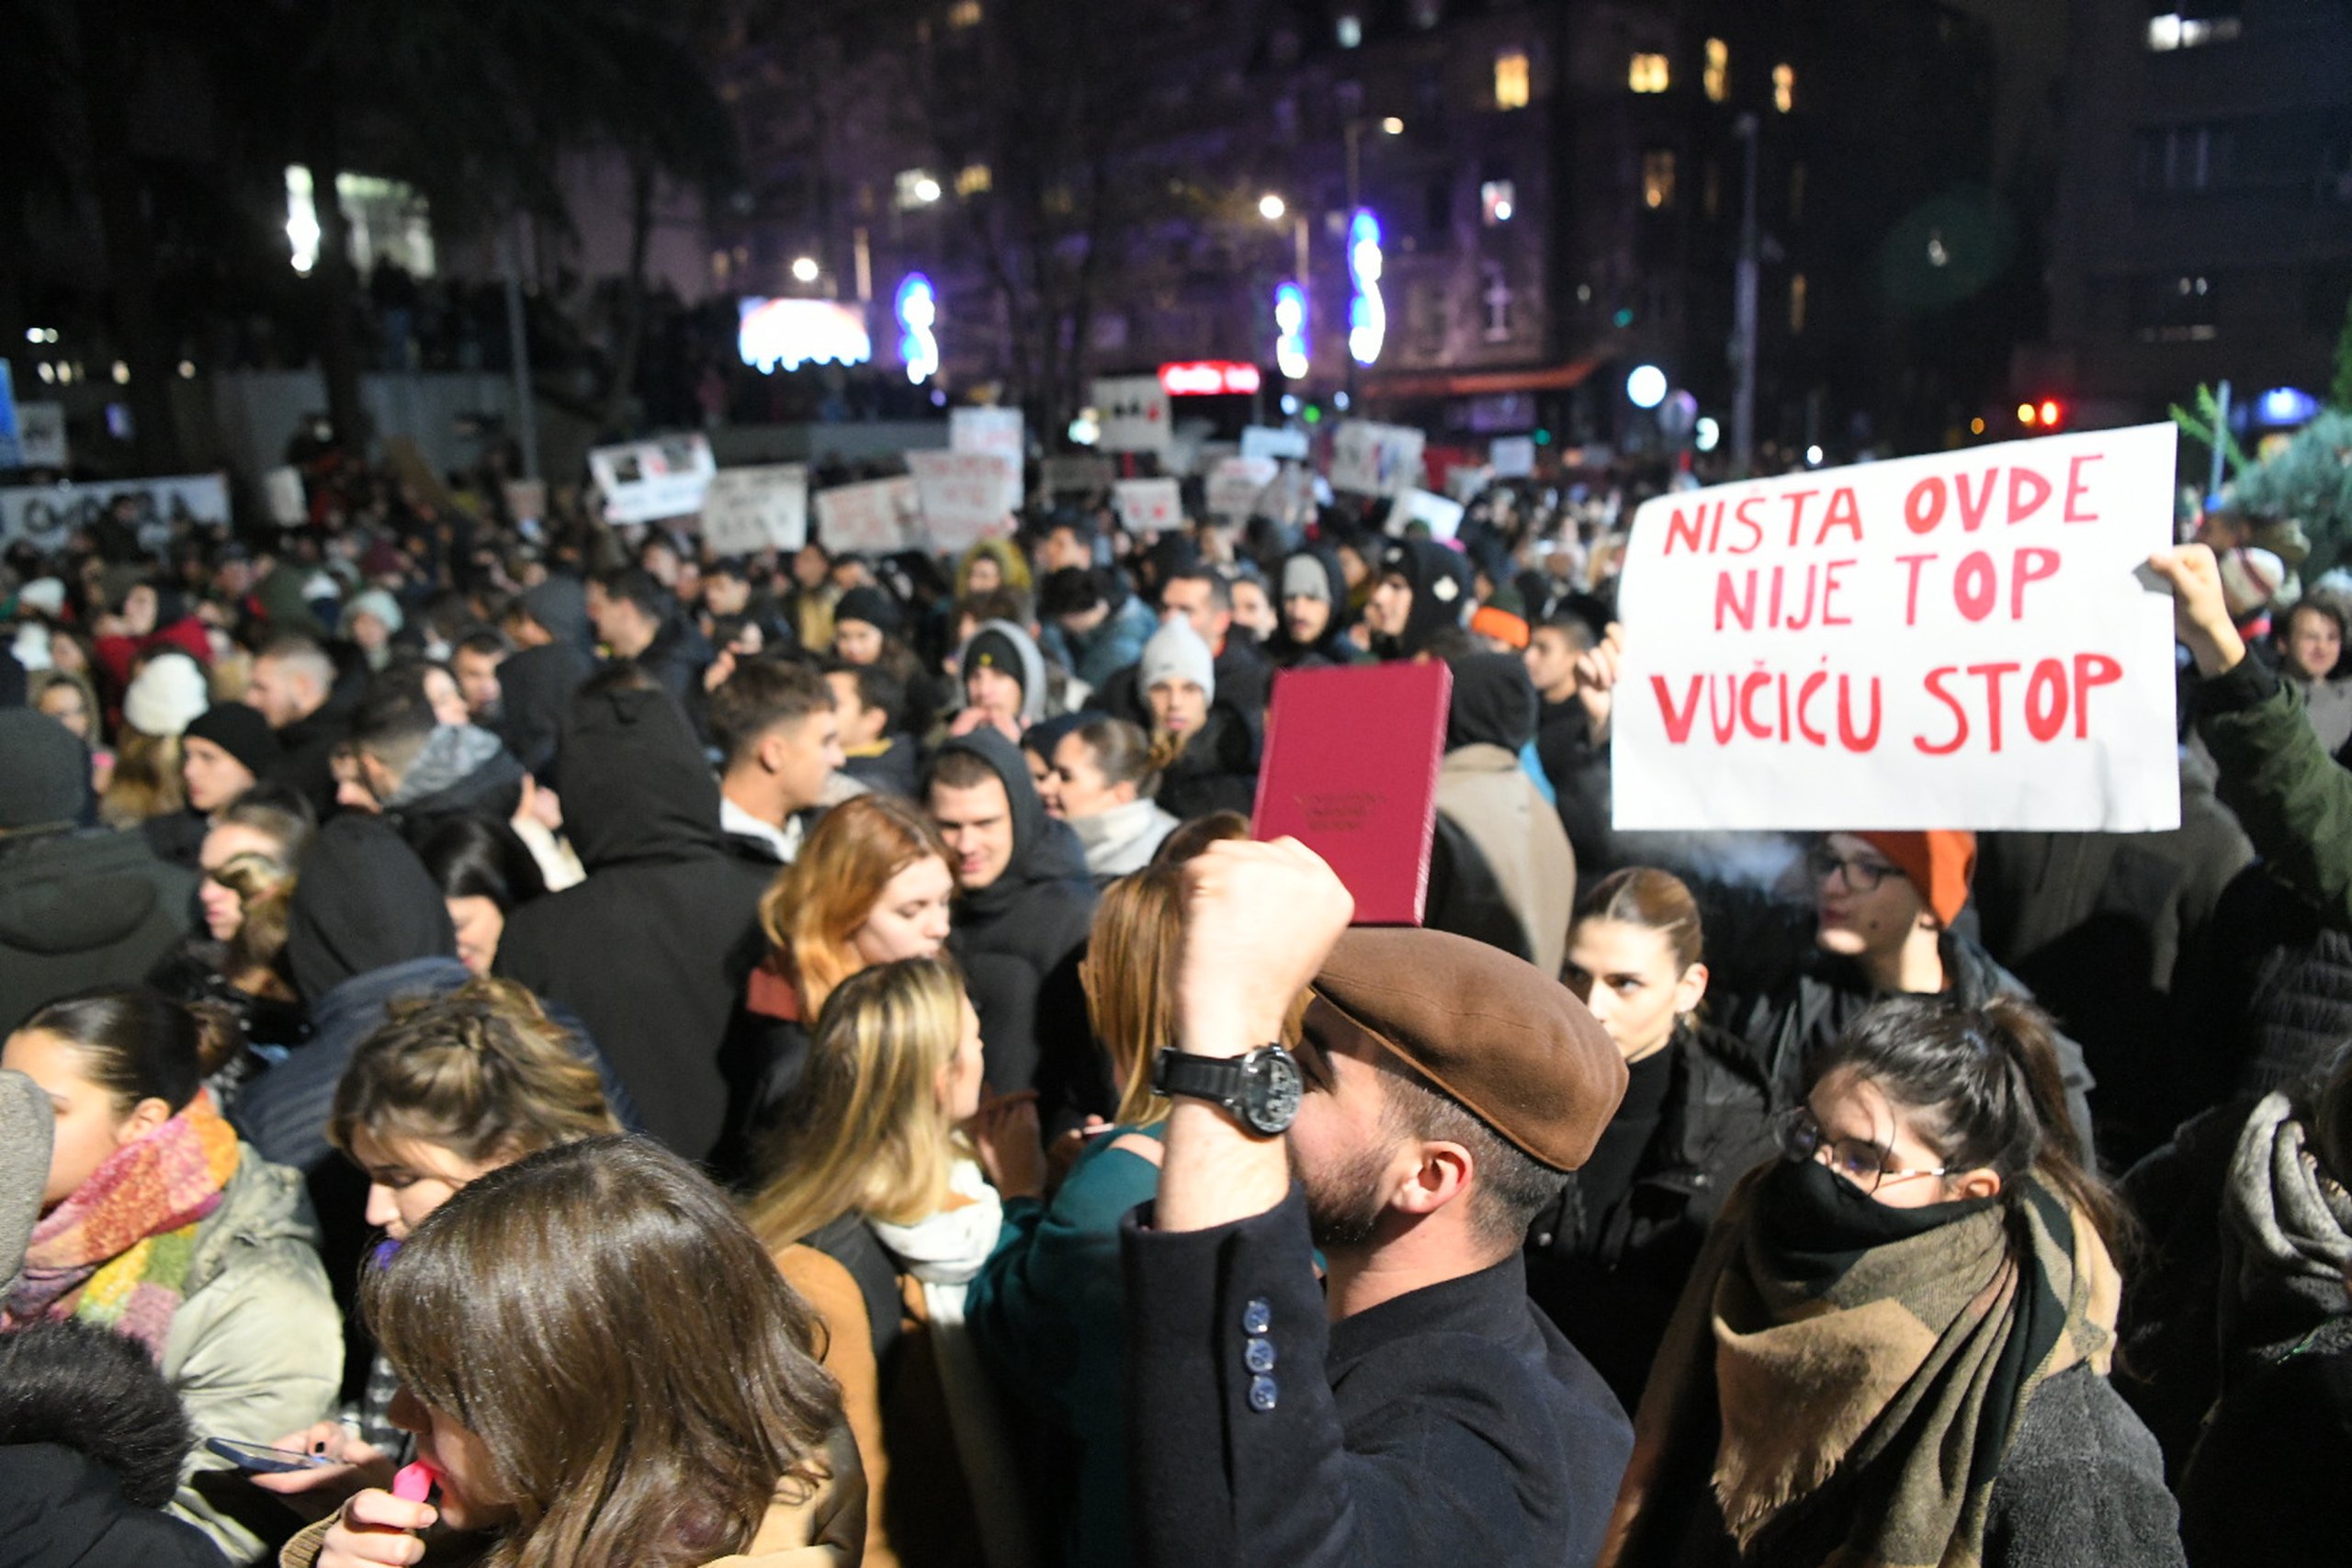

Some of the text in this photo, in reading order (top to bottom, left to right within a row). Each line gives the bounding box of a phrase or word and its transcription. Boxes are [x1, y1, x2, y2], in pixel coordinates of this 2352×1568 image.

[1904, 454, 2104, 536] OVDE
[1713, 547, 2062, 632] NIJE TOP
[1648, 651, 2124, 757] VUČIĆU STOP
